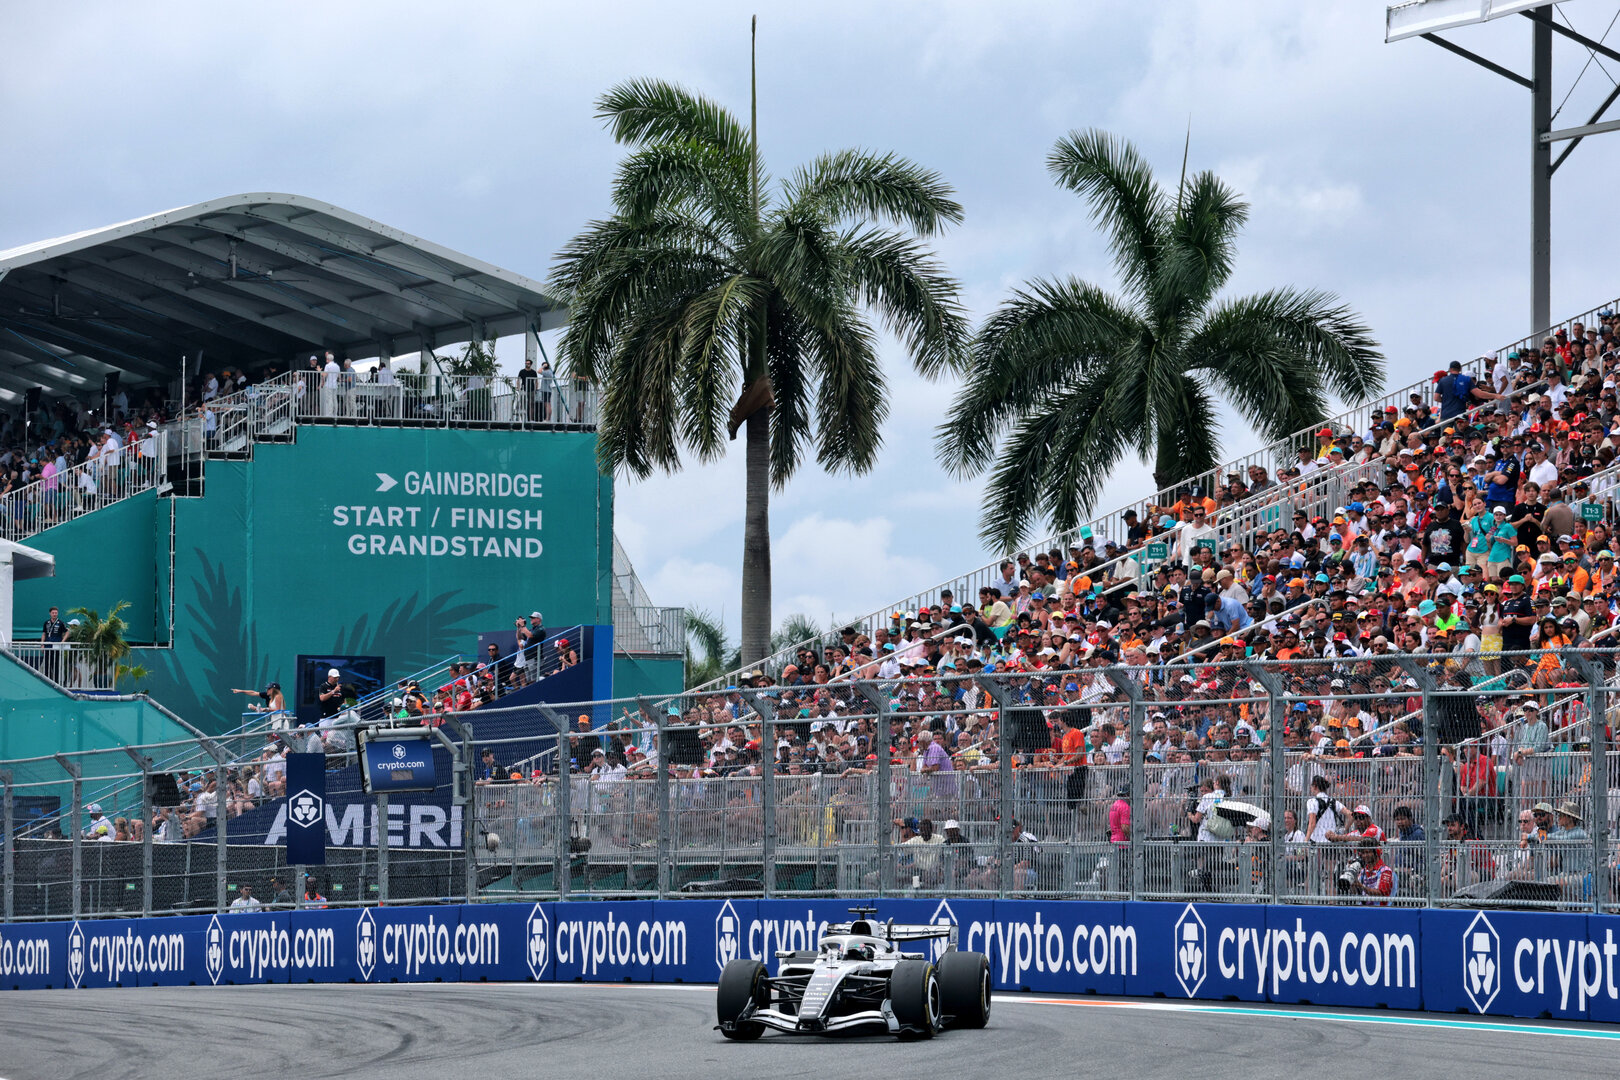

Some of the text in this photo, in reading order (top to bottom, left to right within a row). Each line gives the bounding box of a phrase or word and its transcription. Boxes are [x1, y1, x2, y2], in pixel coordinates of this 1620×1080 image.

[404, 471, 543, 498] GAINBRIDGE
[332, 505, 543, 530] START / FINISH
[347, 534, 543, 559] GRANDSTAND
[377, 760, 426, 770] crypto.com
[89, 928, 186, 982] crypto.com
[229, 921, 335, 979] crypto.com
[382, 914, 500, 975] crypto.com
[556, 911, 687, 976] crypto.com
[967, 911, 1137, 984] crypto.com
[1218, 917, 1416, 995] crypto.com
[1513, 928, 1619, 1012] crypt
